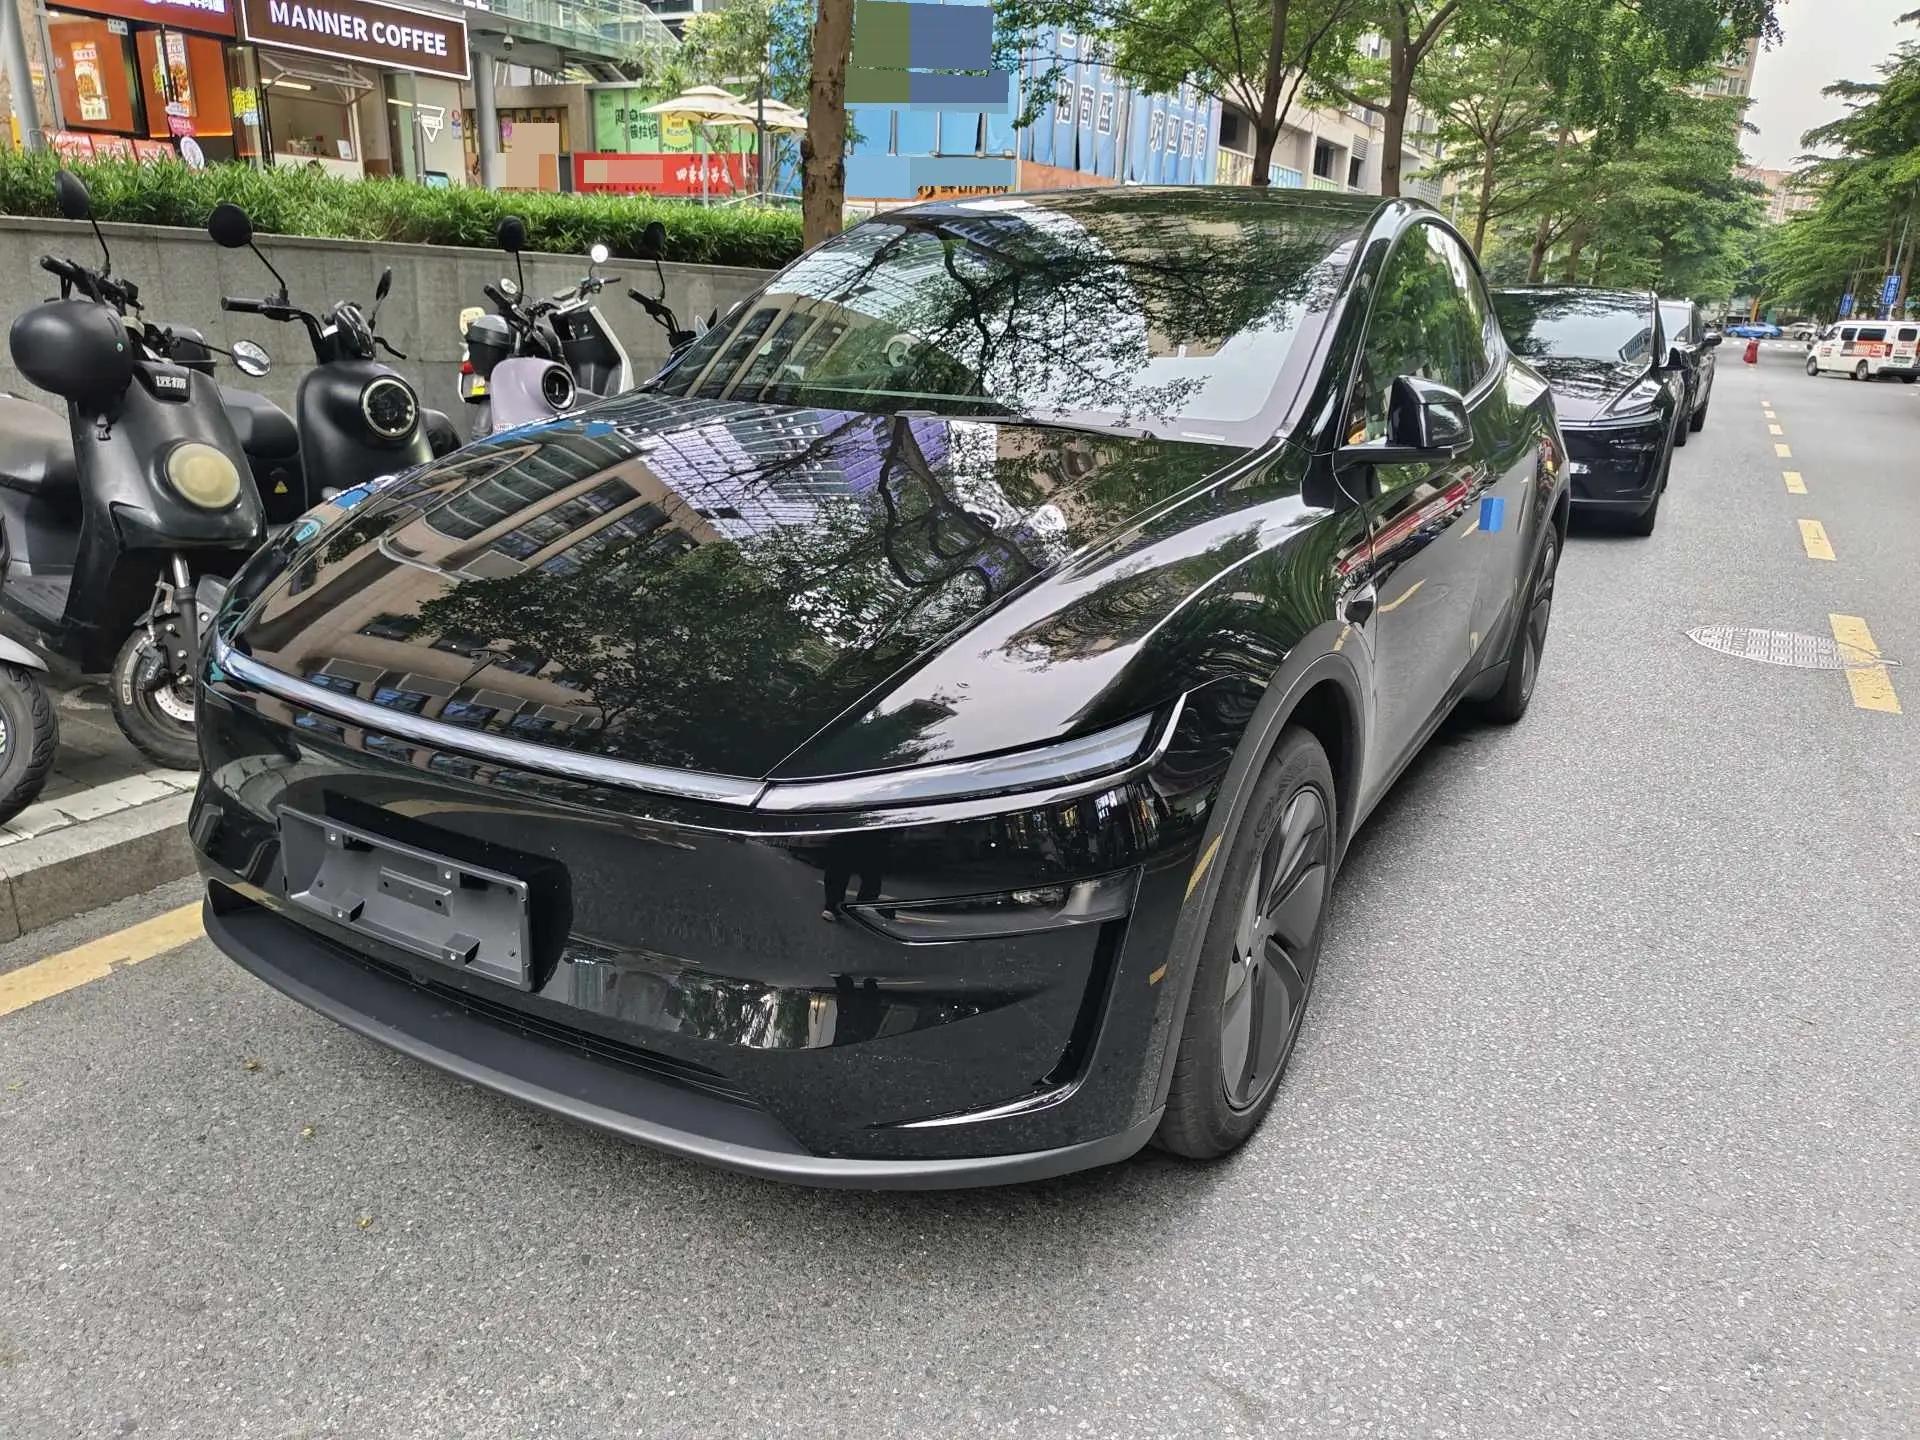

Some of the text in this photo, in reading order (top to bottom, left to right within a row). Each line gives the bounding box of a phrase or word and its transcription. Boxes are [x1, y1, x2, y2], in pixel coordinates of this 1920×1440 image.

[270, 0, 447, 56] MANNER COFFEE
[1056, 77, 1122, 143] 招商盛
